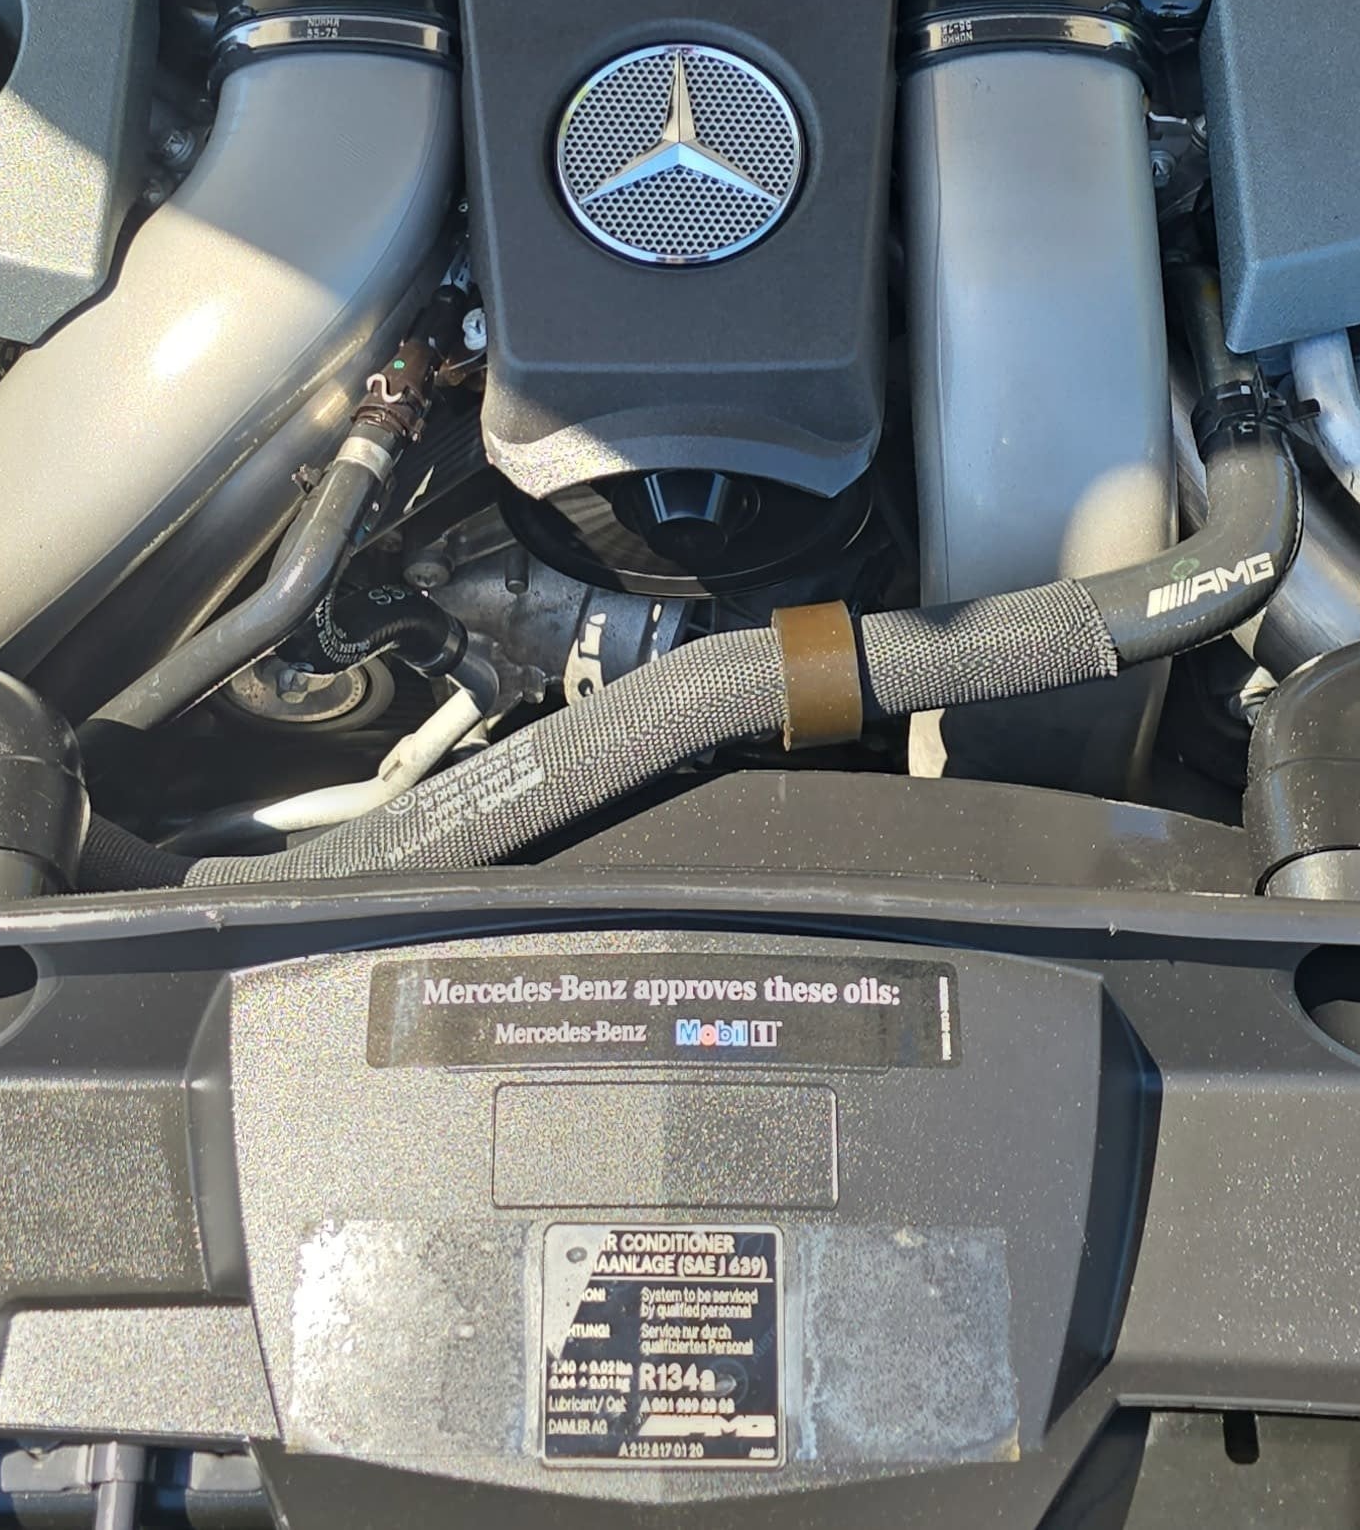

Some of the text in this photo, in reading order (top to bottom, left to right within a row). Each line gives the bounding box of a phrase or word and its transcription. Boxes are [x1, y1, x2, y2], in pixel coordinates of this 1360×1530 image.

[423, 976, 902, 1008] Mercedes-Benz approves these oils:
[495, 1021, 647, 1046] Mercedes-Benz
[675, 1019, 749, 1047] Mobil
[620, 1233, 736, 1253] CONDITIONER
[678, 1255, 716, 1278] (SAE
[728, 1256, 769, 1279] 639)
[640, 1286, 683, 1306] System
[684, 1288, 696, 1303] to
[698, 1288, 711, 1303] be
[712, 1288, 759, 1304] serviced
[640, 1302, 753, 1320] by qualified personnel
[640, 1324, 683, 1339] Service
[684, 1327, 700, 1339] nur
[701, 1324, 732, 1340] durch
[708, 1339, 754, 1355] Personal
[639, 1362, 717, 1391] R134a
[592, 1419, 608, 1435] AG
